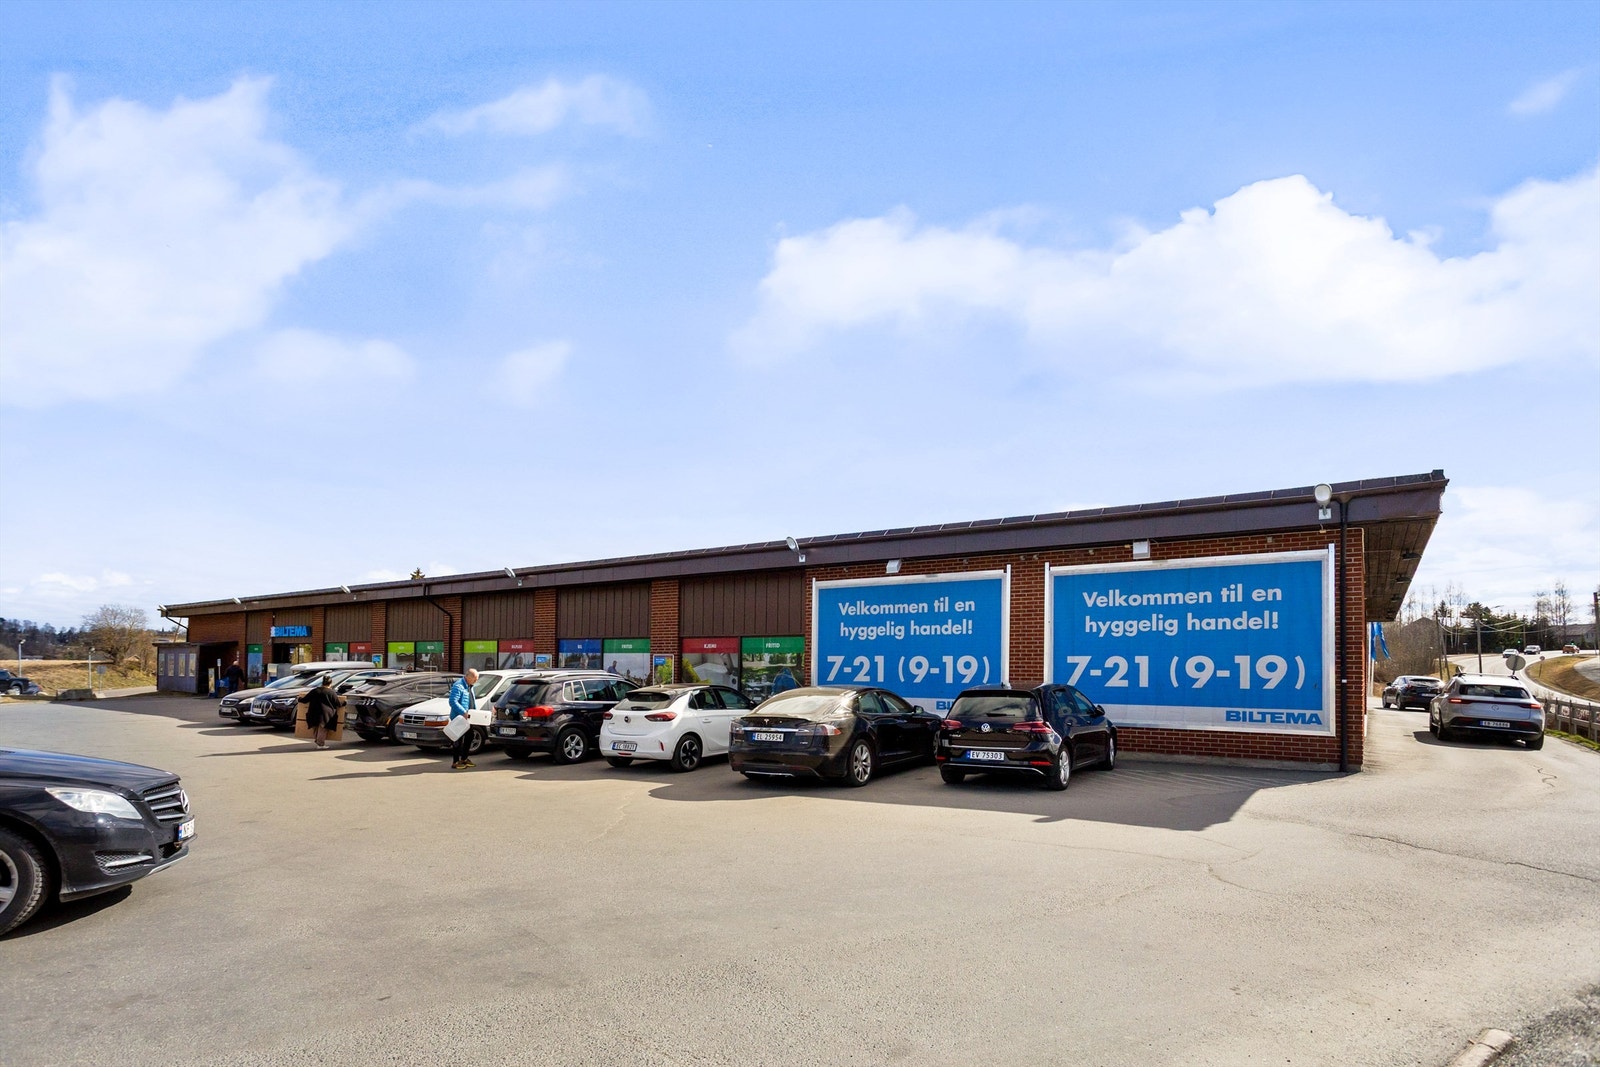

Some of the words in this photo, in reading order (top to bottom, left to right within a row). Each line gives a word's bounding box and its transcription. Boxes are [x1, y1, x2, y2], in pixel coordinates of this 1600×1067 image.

[838, 600, 928, 616] Velkommen
[933, 596, 949, 613] til
[954, 600, 975, 612] en
[1082, 589, 1212, 608] Velkommen
[1220, 583, 1243, 603] til
[1251, 587, 1282, 603] en
[274, 625, 308, 637] BILTEMA
[840, 620, 905, 640] hyggelig
[910, 618, 973, 636] handel!
[1085, 613, 1178, 638] hyggelig
[1186, 610, 1279, 631] handel!
[827, 655, 885, 683] 7-21
[898, 655, 990, 685] (9-19)
[1067, 655, 1149, 688] 7-21
[1169, 654, 1306, 690] (9-19)
[1225, 710, 1323, 725] BILTEMA
[764, 733, 783, 741] 25954
[971, 751, 980, 759] EV
[982, 752, 1003, 760] 75303
